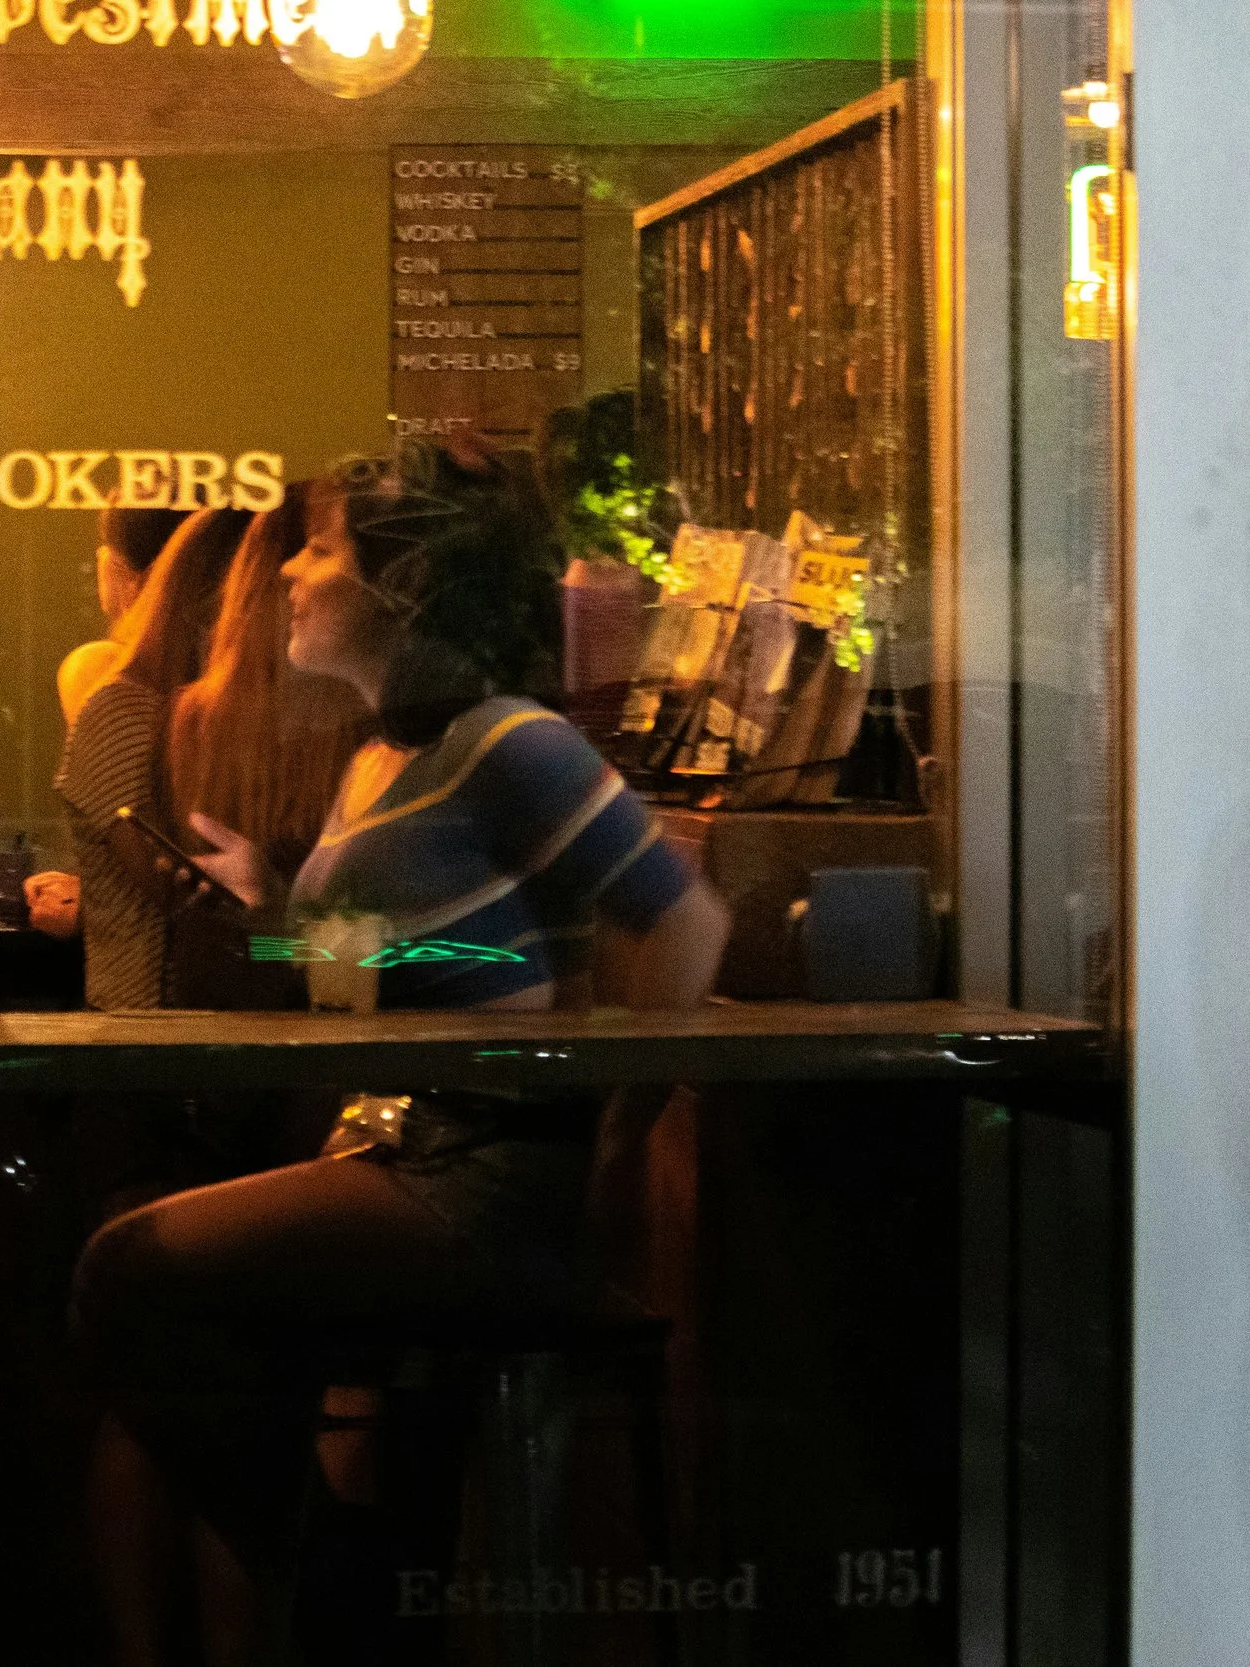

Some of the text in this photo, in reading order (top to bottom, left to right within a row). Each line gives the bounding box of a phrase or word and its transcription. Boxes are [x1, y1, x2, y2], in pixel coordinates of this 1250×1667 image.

[395, 160, 528, 179] COCKTAILS
[395, 193, 497, 210] WHISKEY
[396, 225, 478, 242] VODKA
[395, 257, 440, 274] GIN
[396, 289, 449, 306] RUM
[395, 320, 498, 338] TEQUILA
[398, 353, 534, 371] MICHELADA
[394, 1547, 944, 1617] Established 1951
